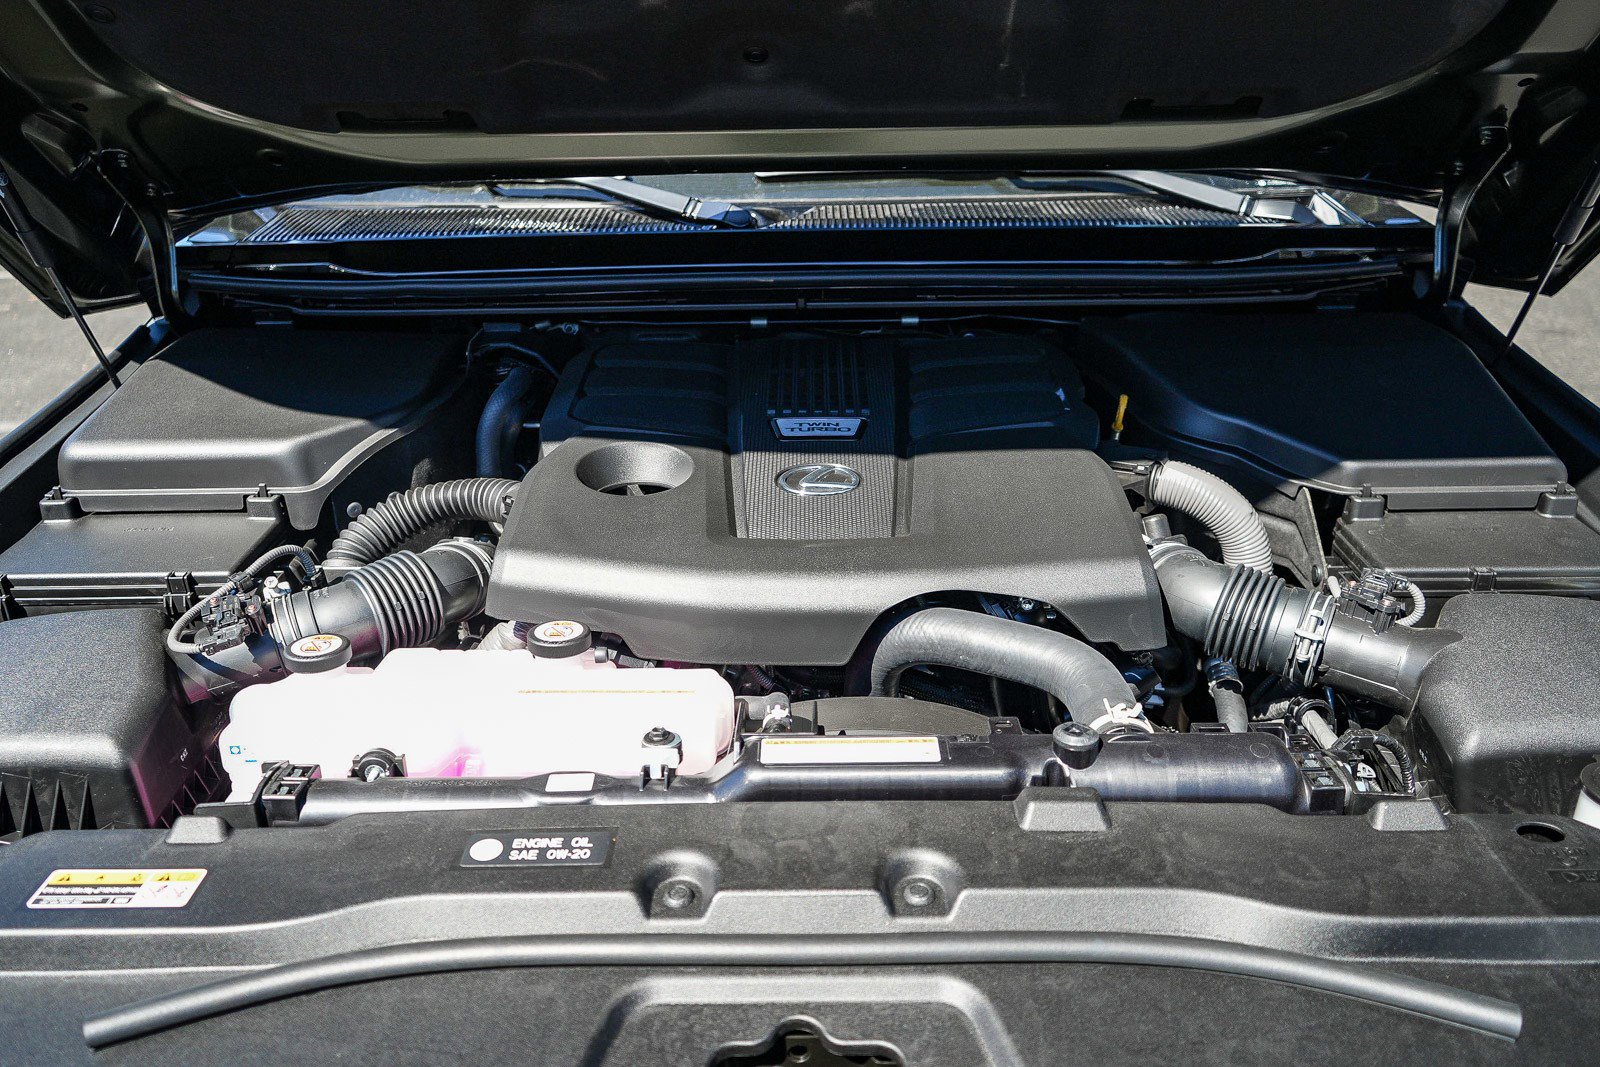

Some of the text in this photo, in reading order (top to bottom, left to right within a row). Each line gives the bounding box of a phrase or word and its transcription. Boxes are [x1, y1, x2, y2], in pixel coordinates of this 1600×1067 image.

[512, 836, 594, 848] ENGINE OIL
[508, 848, 591, 860] SAE 0W-20
